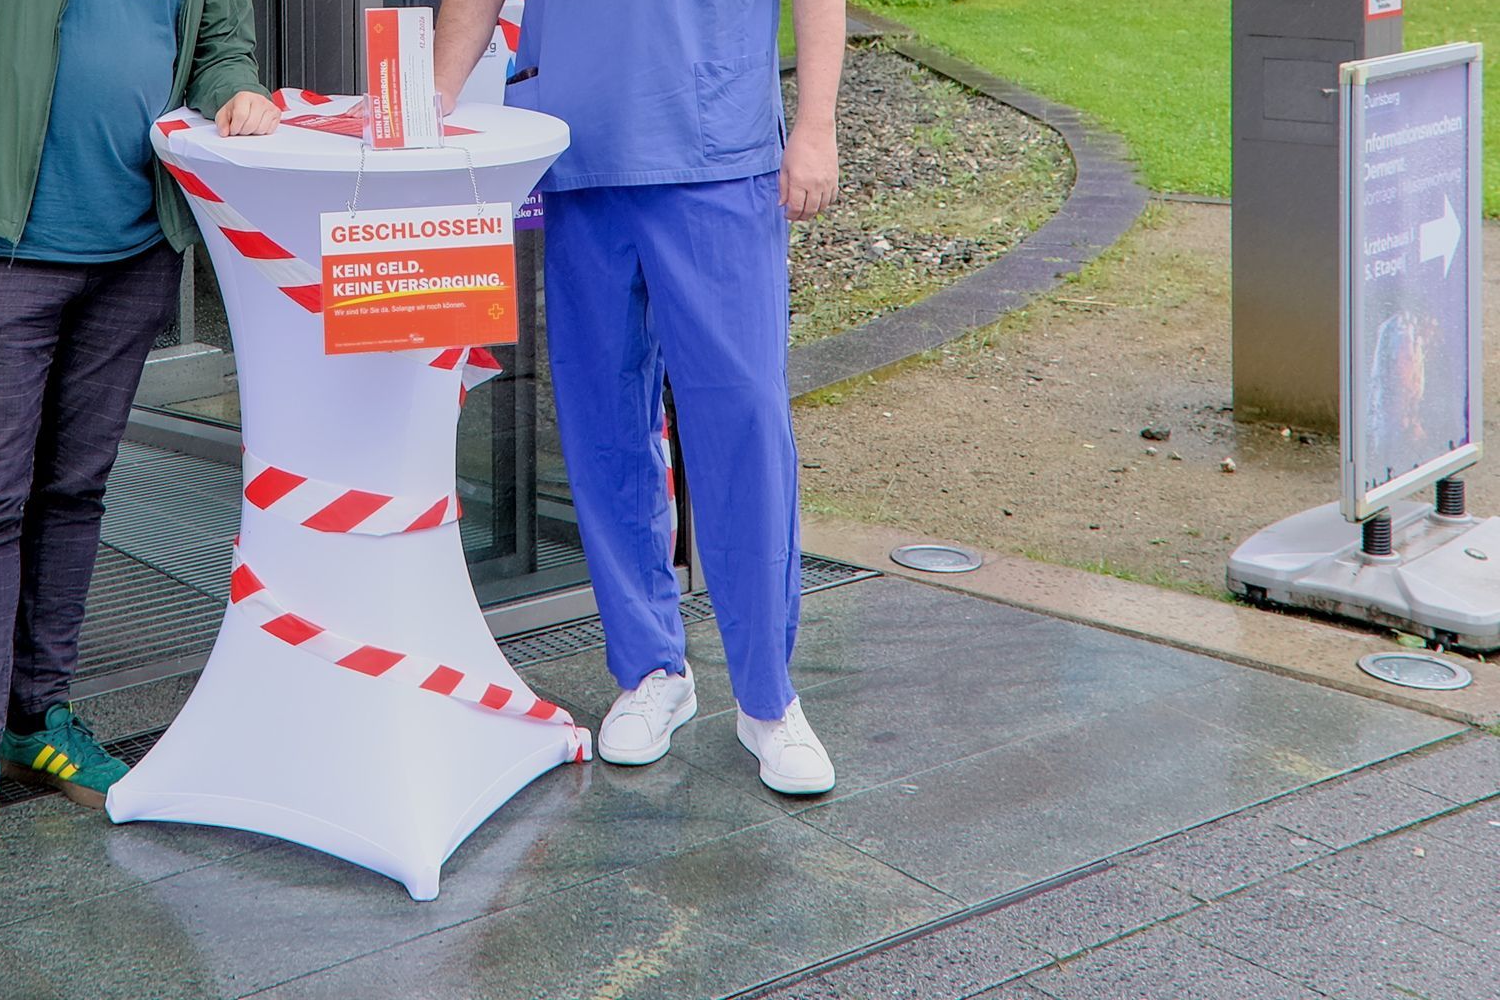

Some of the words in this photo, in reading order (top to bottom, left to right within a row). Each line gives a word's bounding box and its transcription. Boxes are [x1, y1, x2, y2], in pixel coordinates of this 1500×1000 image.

[1364, 114, 1463, 155] nformationswochen
[331, 217, 503, 244] GESCHLOSSEN!
[332, 262, 373, 279] KEIN
[376, 260, 425, 276] GELD.
[332, 281, 384, 298] KEINE
[386, 272, 505, 294] VERSORGUNG.
[334, 308, 346, 317] Wir
[346, 307, 360, 316] sind
[359, 307, 370, 316] für
[370, 306, 380, 315] Sie
[390, 304, 416, 314] Solange
[426, 302, 442, 311] noch
[442, 300, 467, 310] können.
